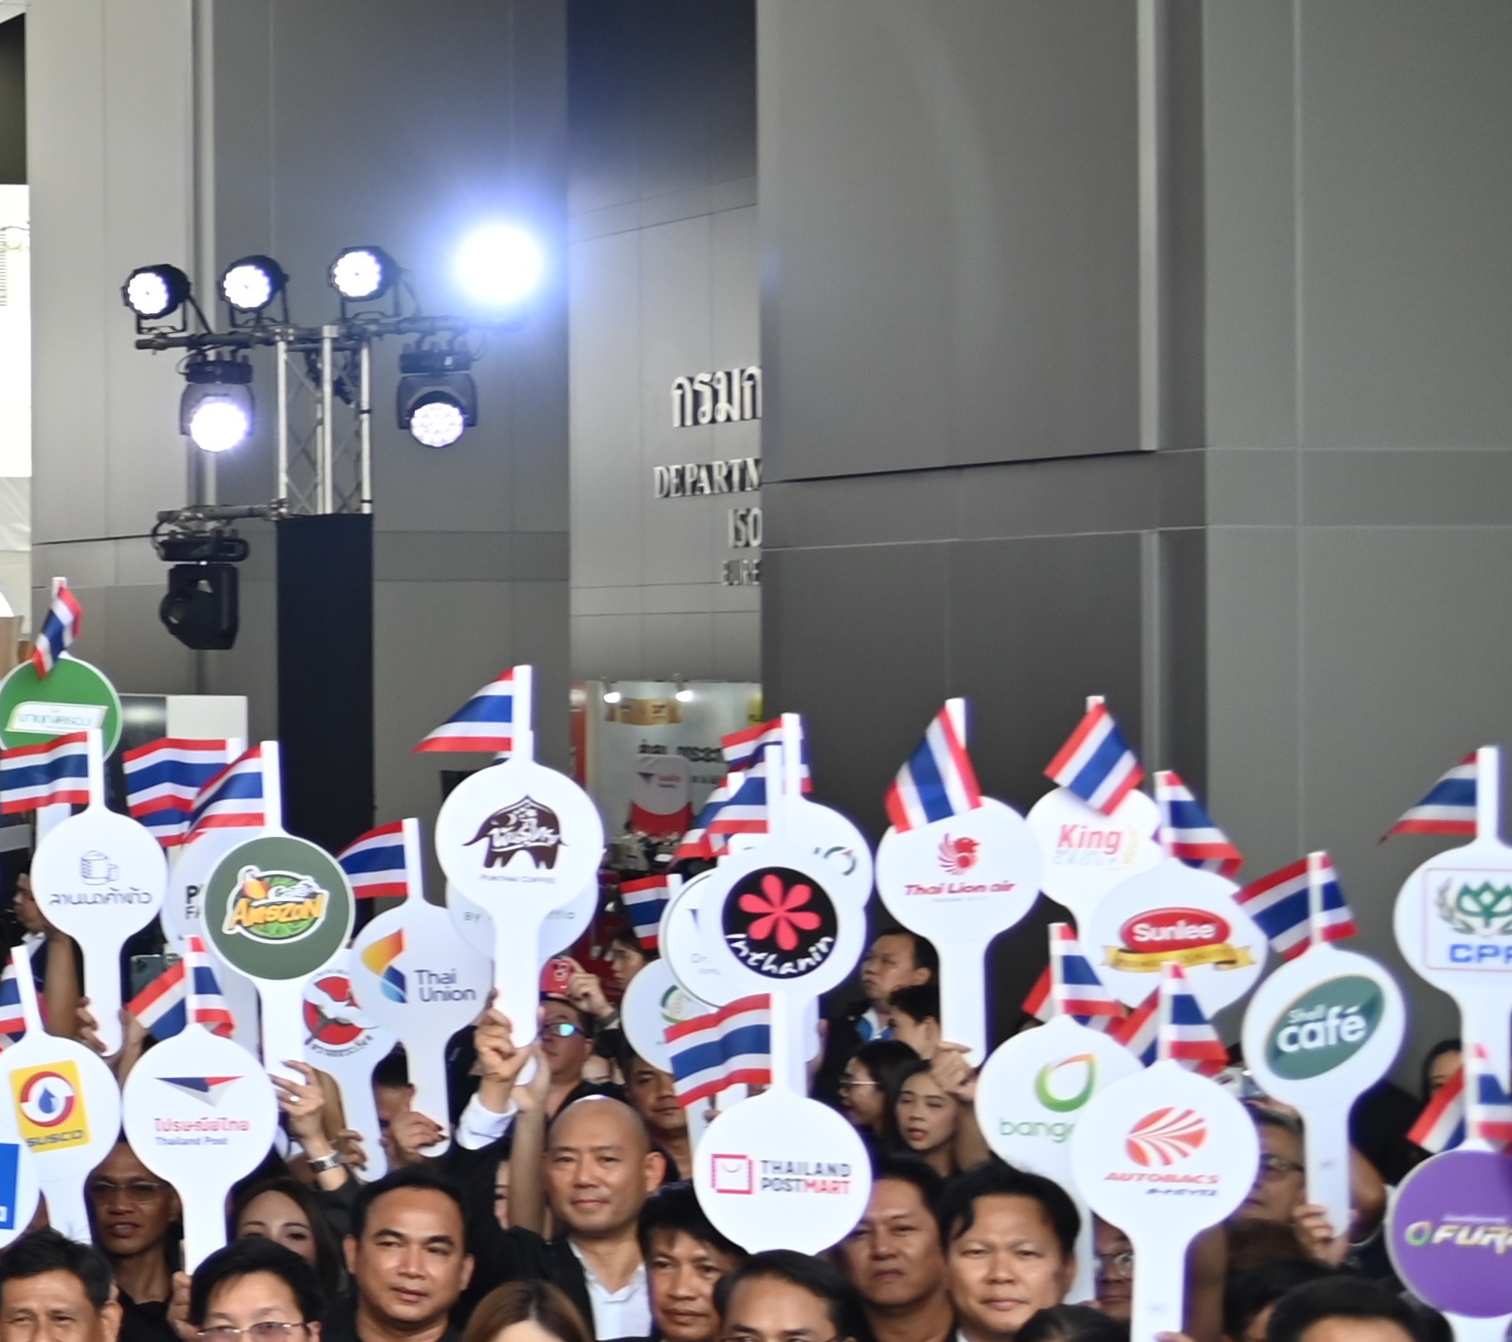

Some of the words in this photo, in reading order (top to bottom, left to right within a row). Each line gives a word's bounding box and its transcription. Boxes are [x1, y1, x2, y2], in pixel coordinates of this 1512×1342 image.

[1057, 824, 1123, 855] King
[905, 883, 944, 897] Thai
[947, 882, 988, 895] Lion
[990, 880, 1017, 894] air
[1132, 920, 1216, 944] Sunlee
[413, 968, 457, 986] Thai
[418, 985, 477, 1003] Union
[1275, 1007, 1367, 1053] café
[154, 1135, 203, 1147] Thailand
[204, 1135, 229, 1147] Post
[761, 1159, 852, 1178] THAILAND
[760, 1177, 851, 1194] POSTMART
[1105, 1171, 1219, 1185] AUTOBACS
